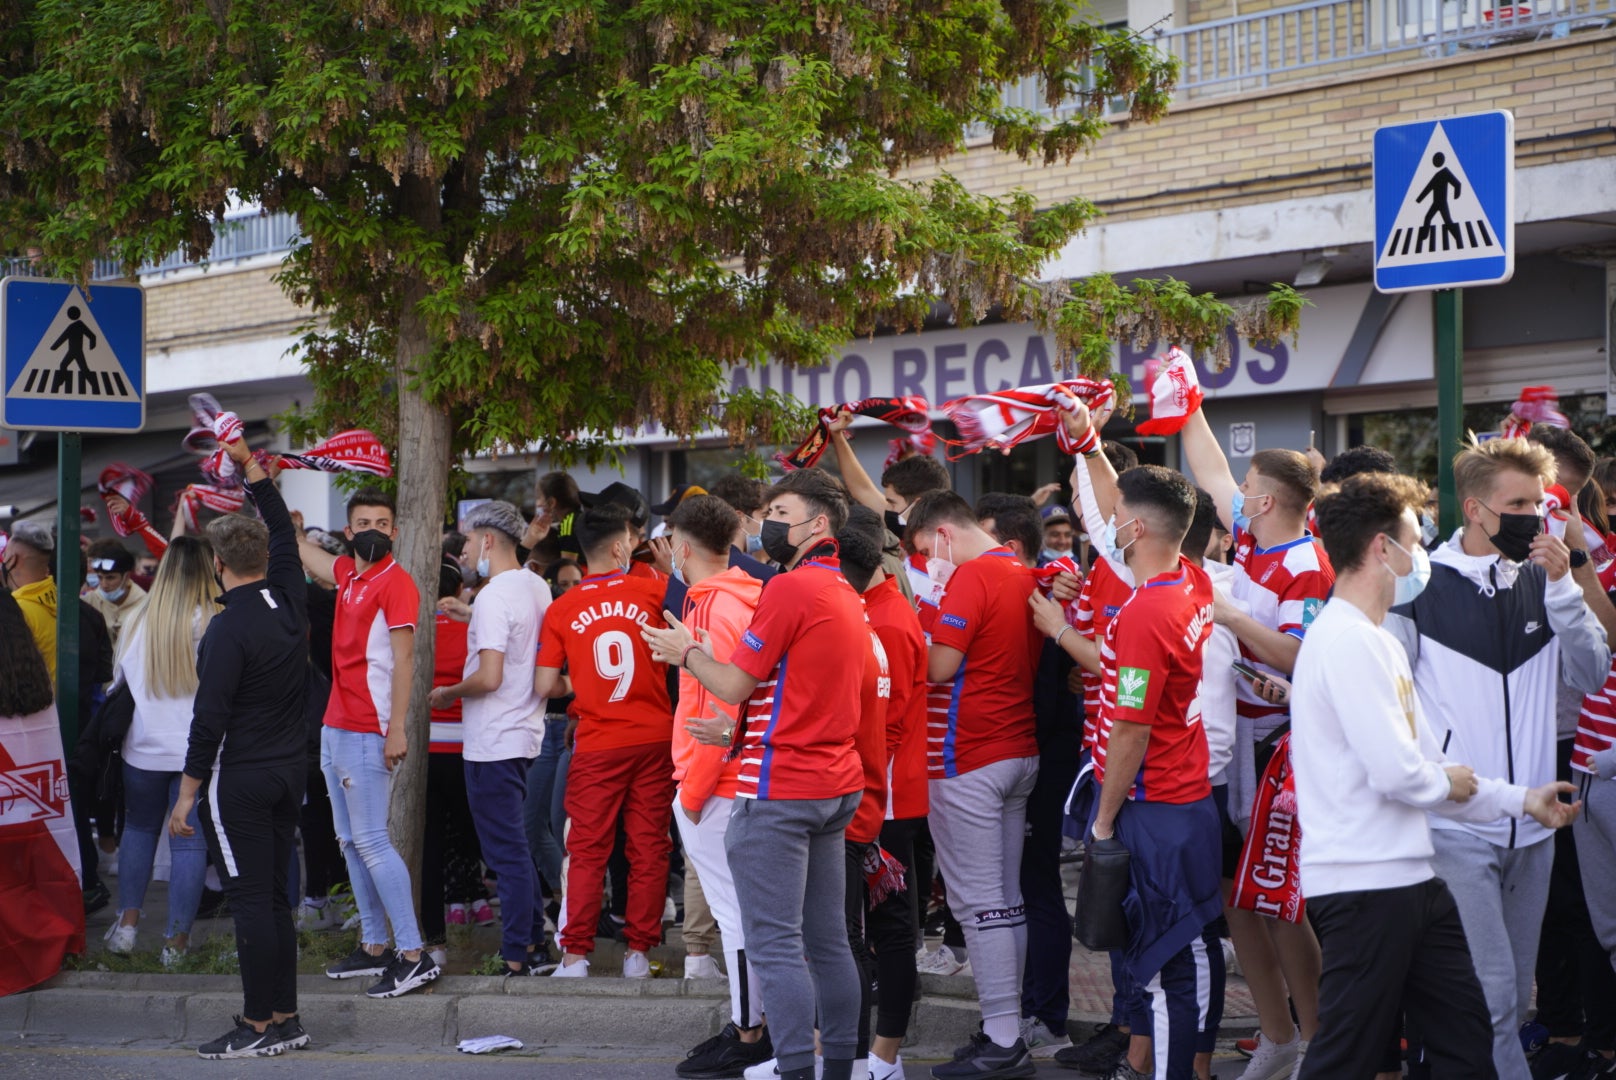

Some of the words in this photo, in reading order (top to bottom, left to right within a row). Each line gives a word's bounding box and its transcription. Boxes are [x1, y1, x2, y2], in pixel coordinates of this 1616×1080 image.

[728, 354, 872, 406] AUTO
[571, 601, 649, 634] SOLDADO
[593, 630, 635, 703] 9
